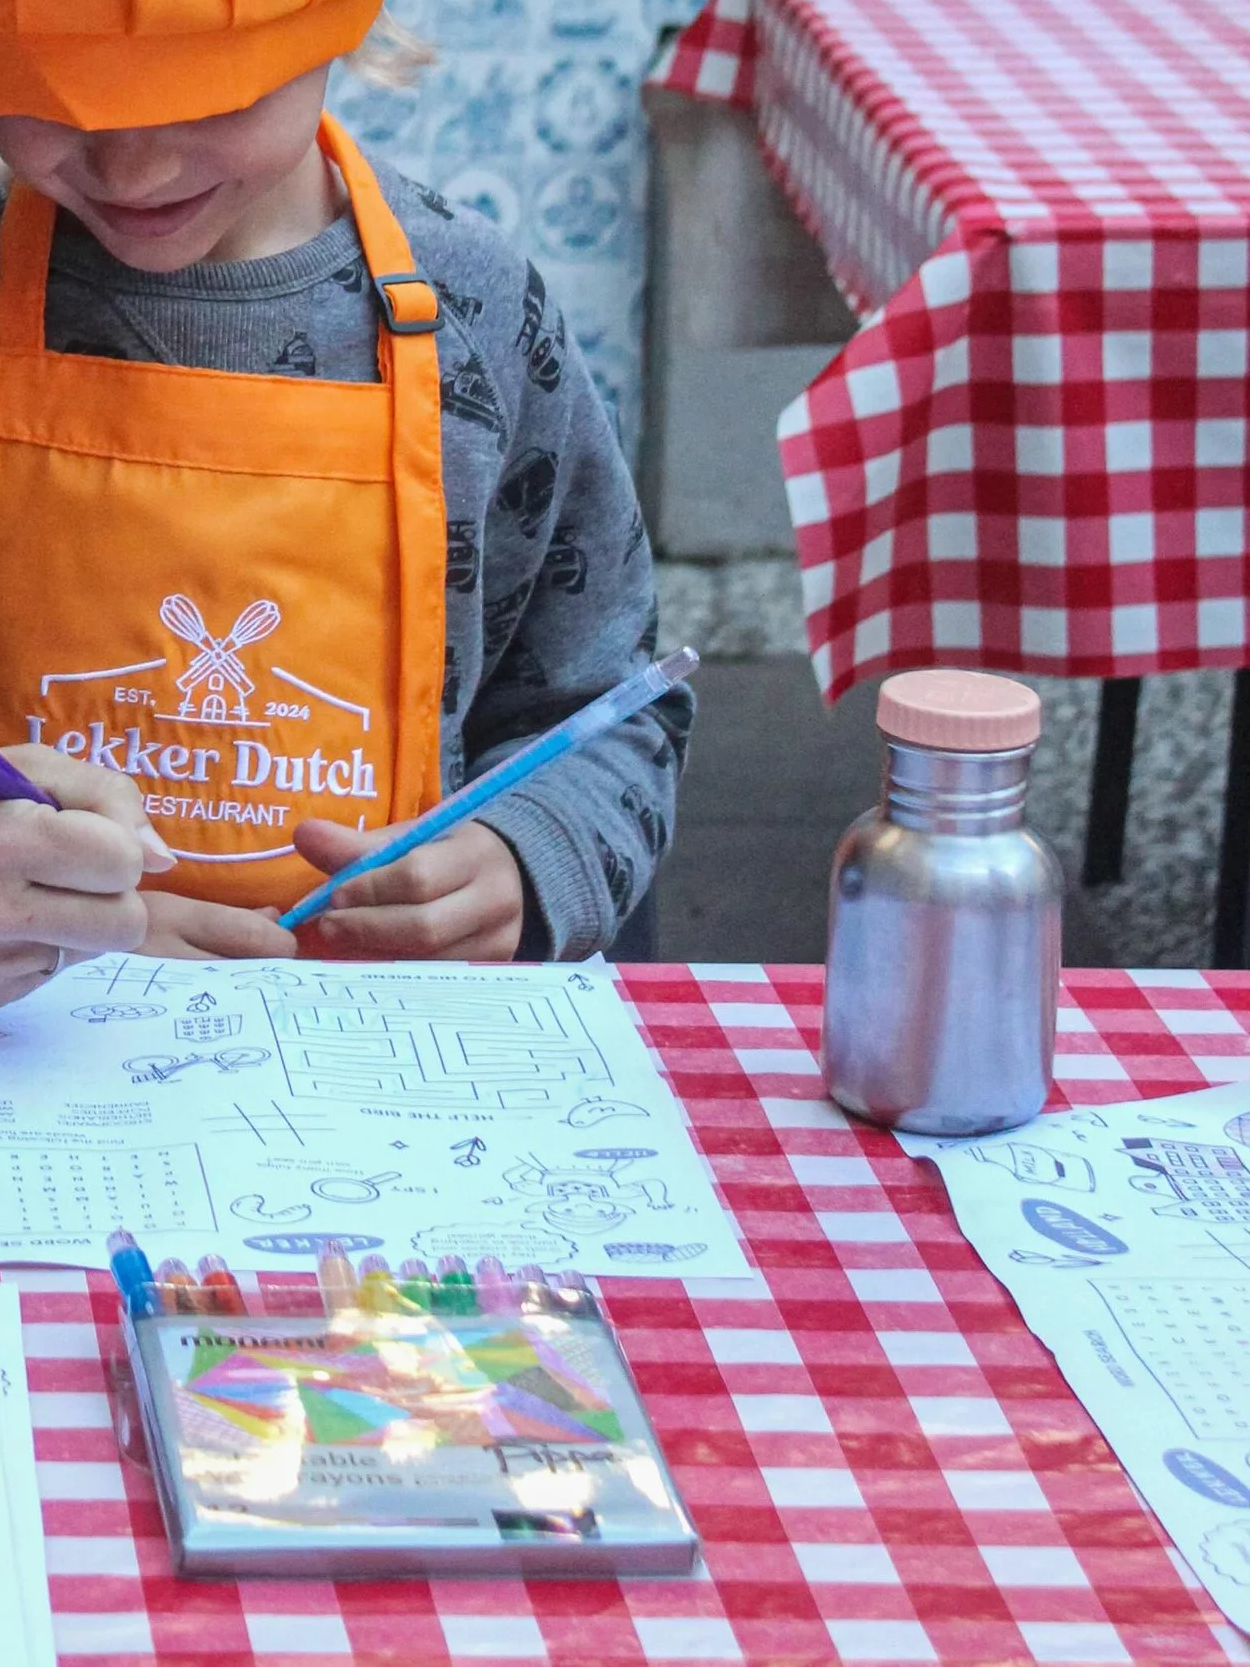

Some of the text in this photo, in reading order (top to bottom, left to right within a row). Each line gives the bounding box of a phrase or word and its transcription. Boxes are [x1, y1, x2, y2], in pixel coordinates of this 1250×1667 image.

[113, 686, 157, 708] EST.
[265, 700, 310, 721] 2024
[233, 740, 378, 799] Dutch
[143, 794, 290, 827] ESTAURANT
